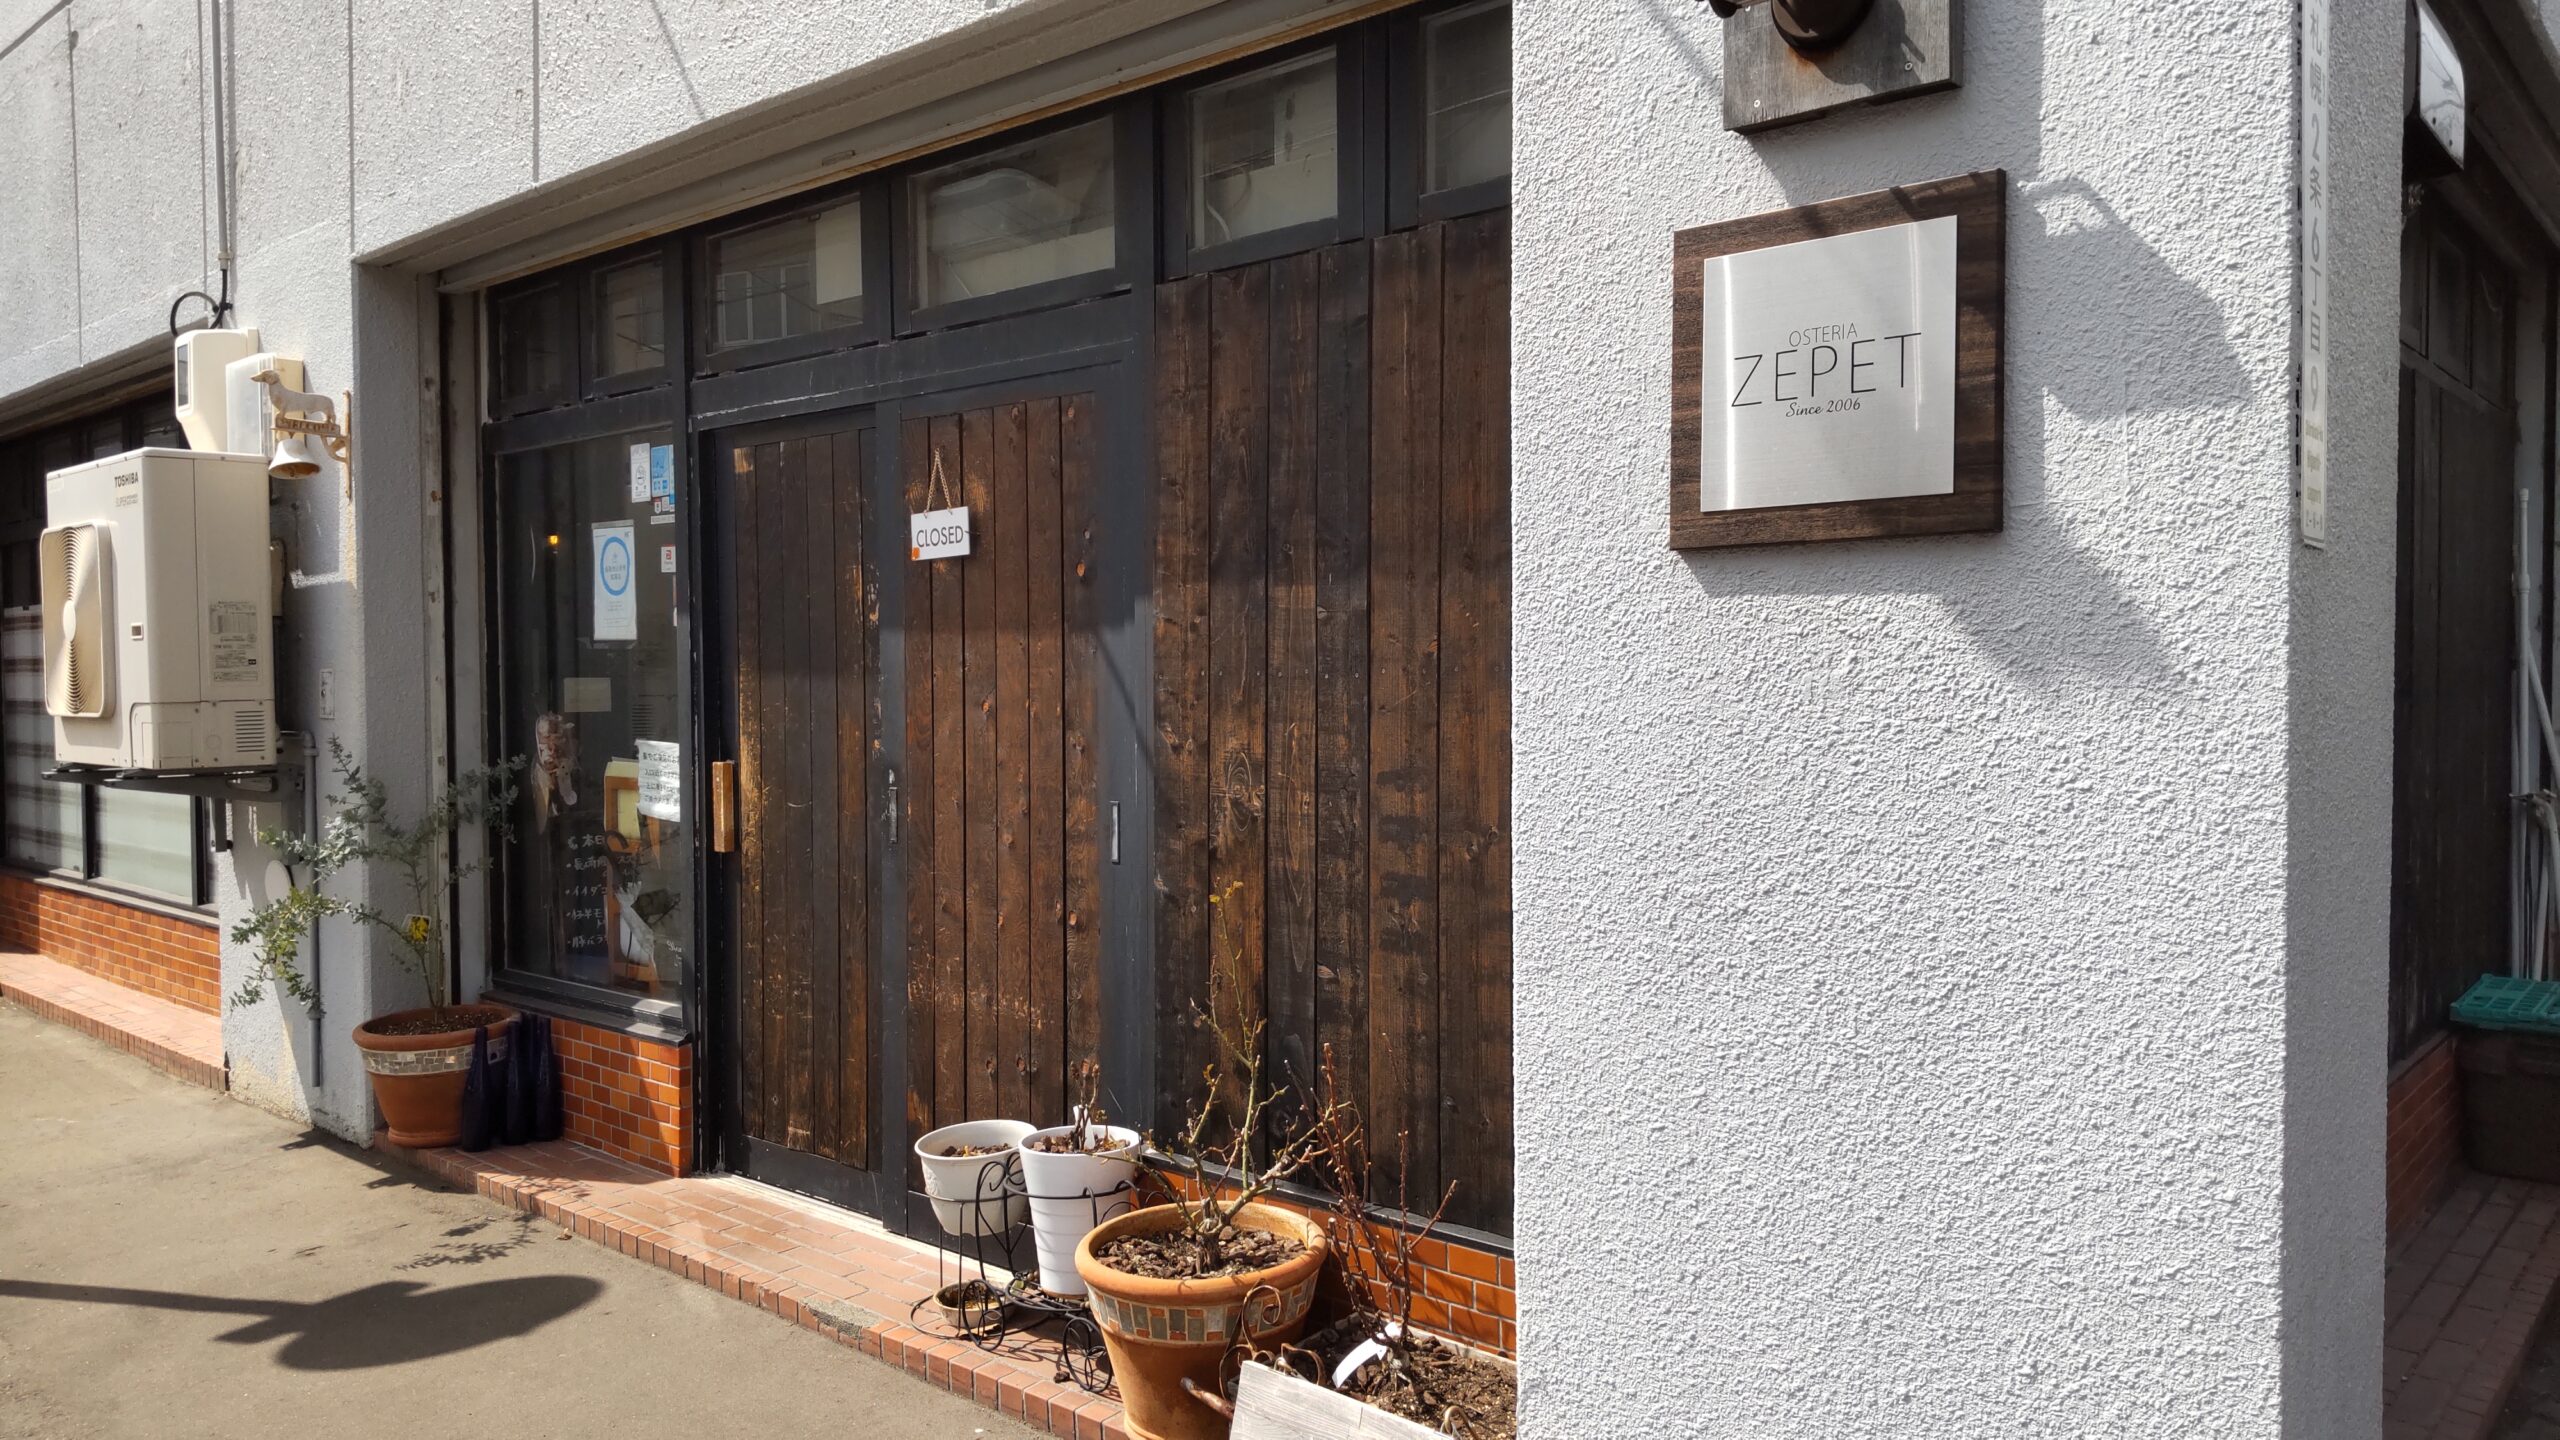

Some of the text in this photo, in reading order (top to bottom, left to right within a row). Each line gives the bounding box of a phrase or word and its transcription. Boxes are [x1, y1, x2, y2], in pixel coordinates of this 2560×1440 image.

[1788, 322, 1858, 348] OSTERIA
[1731, 332, 1922, 407] ZEPET
[1785, 398, 1862, 418] Since 2006
[114, 472, 139, 488] TOSHIBA
[916, 525, 964, 548] CLOSED
